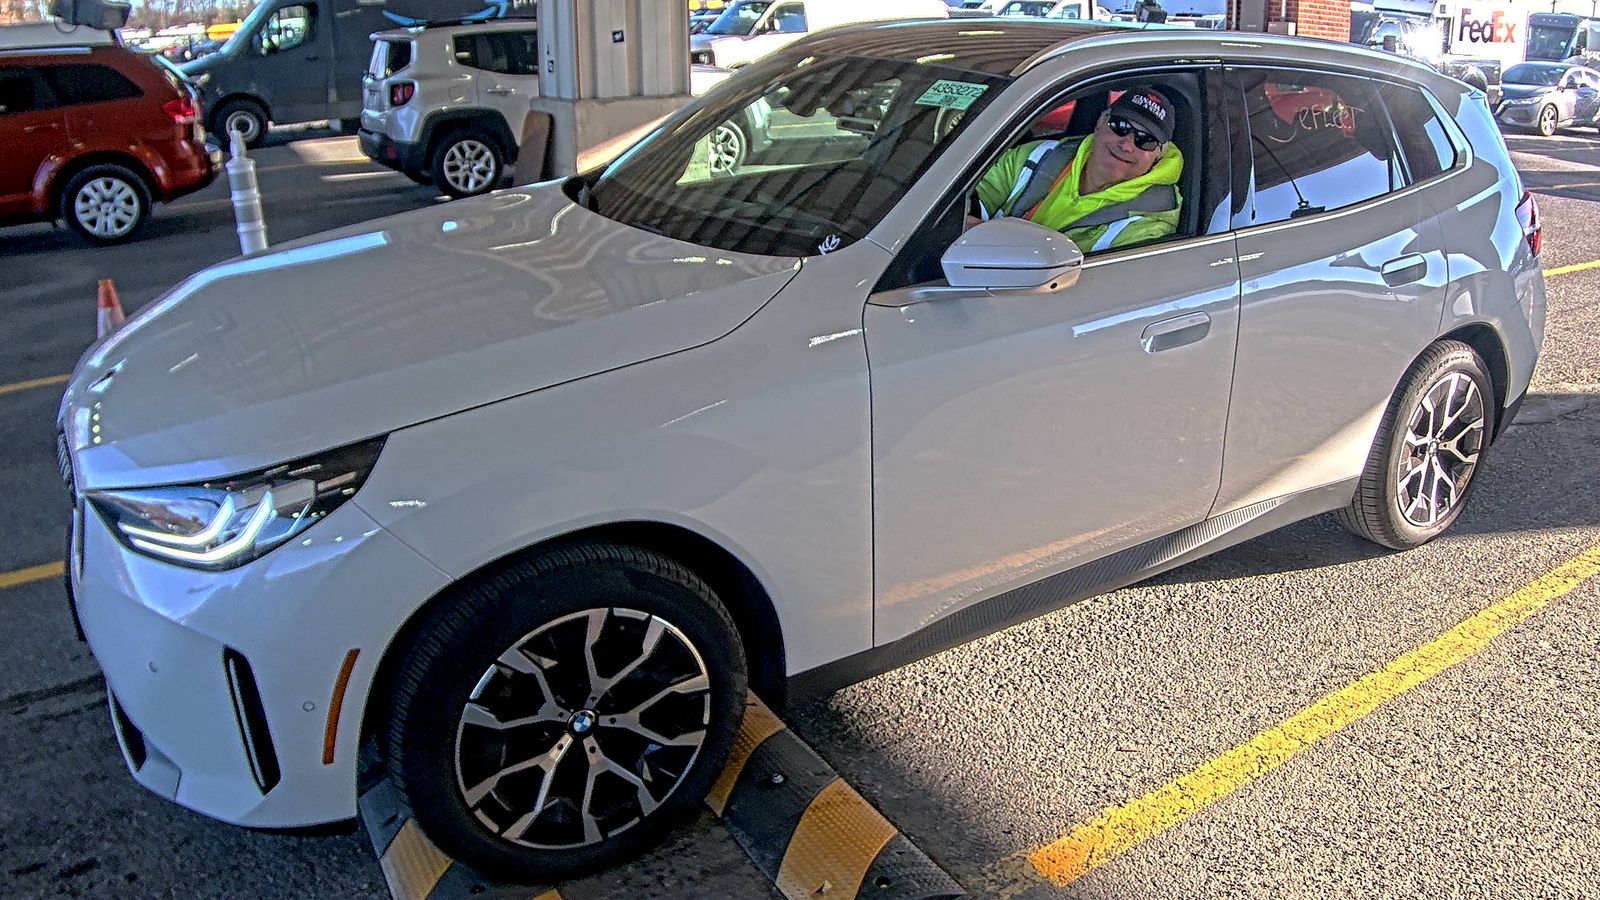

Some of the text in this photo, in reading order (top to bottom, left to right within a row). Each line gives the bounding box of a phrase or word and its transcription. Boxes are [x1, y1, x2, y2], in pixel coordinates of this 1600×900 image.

[1459, 8, 1516, 43] FedEx
[931, 83, 984, 97] 4353272
[1132, 94, 1161, 111] CANADA
